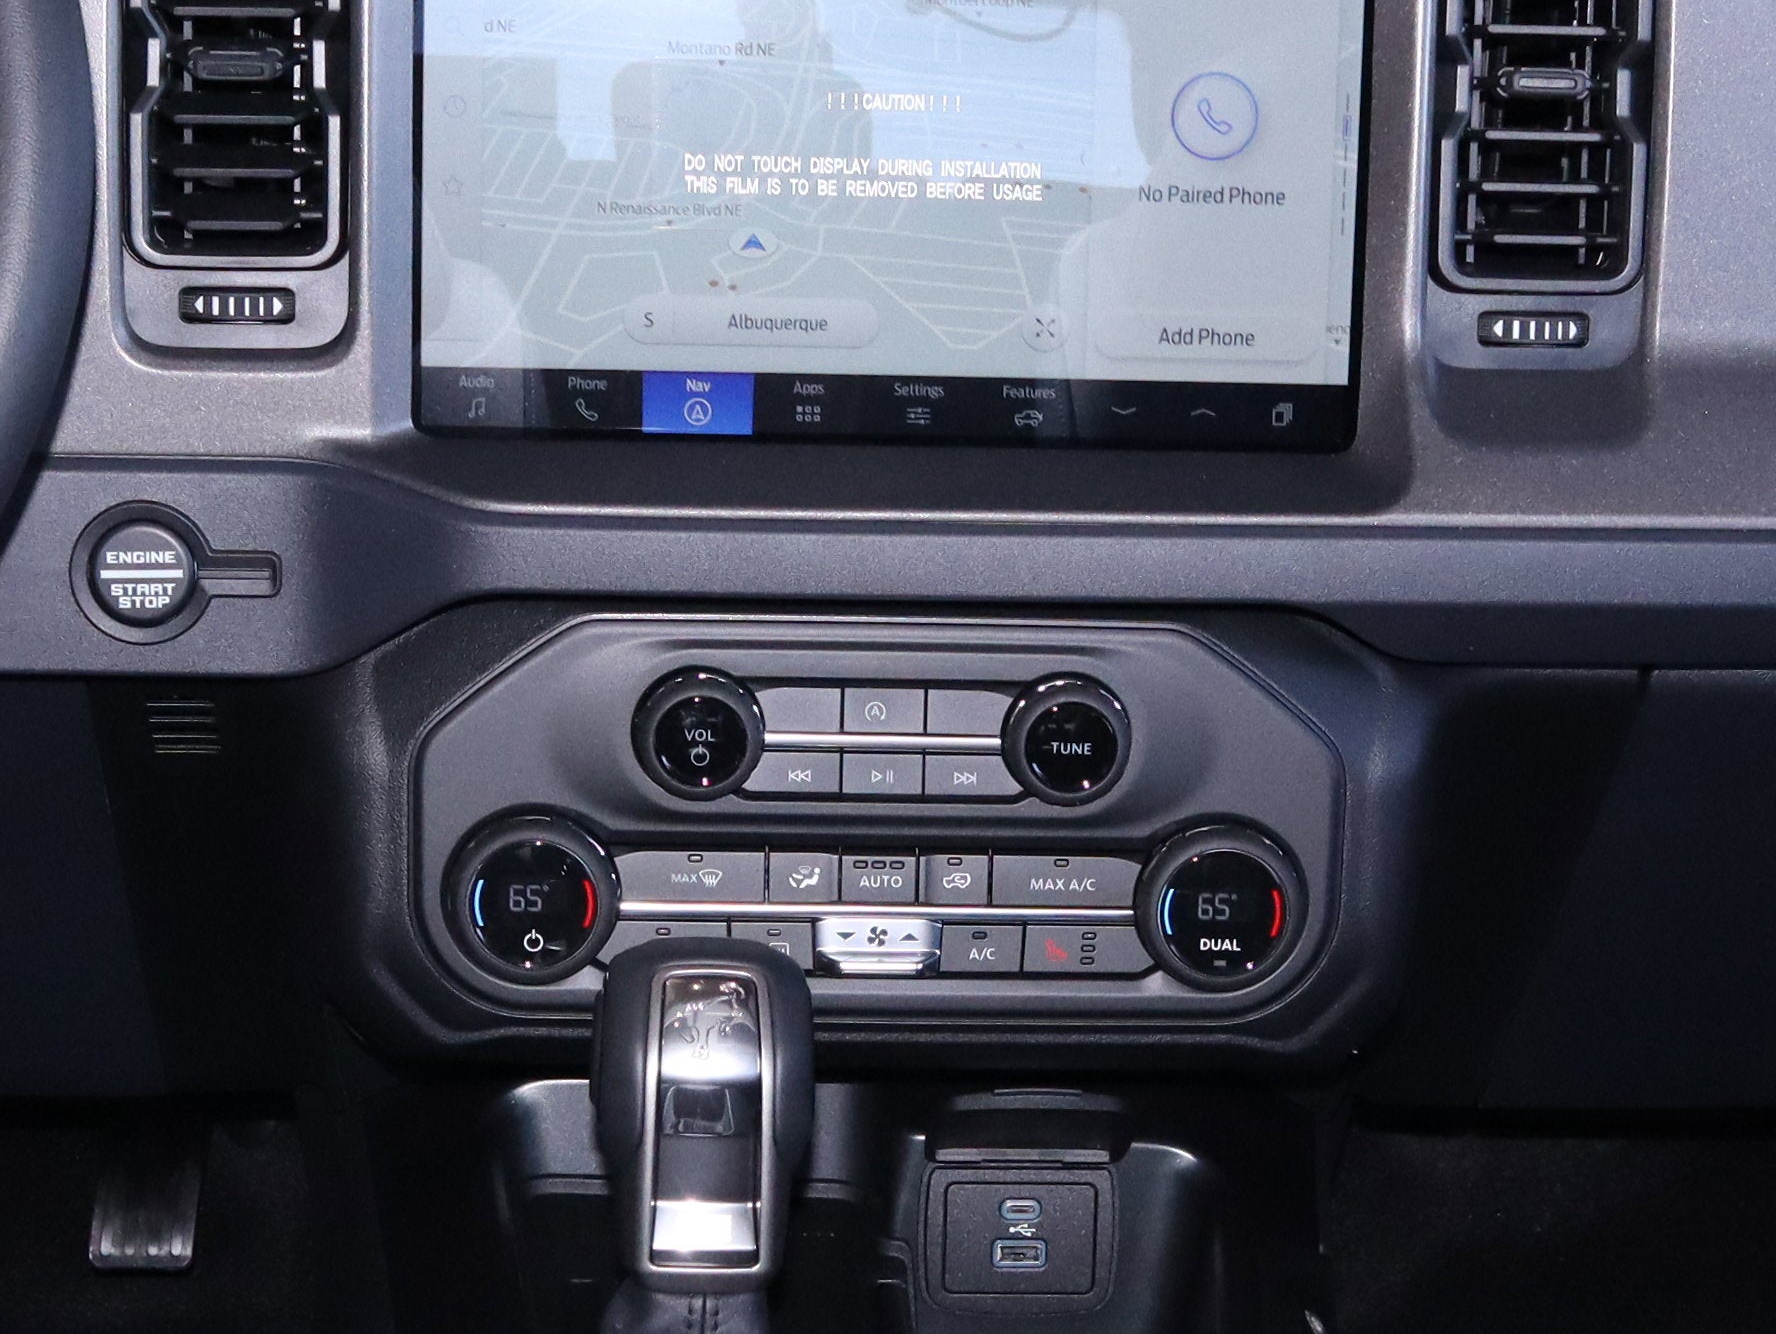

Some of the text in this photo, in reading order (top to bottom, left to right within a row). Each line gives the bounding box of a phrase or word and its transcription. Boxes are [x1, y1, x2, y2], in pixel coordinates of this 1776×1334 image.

[498, 19, 517, 33] NE
[735, 42, 752, 56] Rd
[756, 43, 776, 56] NE
[684, 154, 1042, 179] DO NOT TOUCH DISPLAY DURING INSTALLATION
[685, 175, 1043, 201] THIS FILM IS TO BE REMOVED BEFORE USAGE
[1138, 186, 1286, 206] No Paired Phone
[597, 201, 743, 216] N Renaissance Blvd NE
[644, 313, 654, 328] S
[728, 314, 828, 334] Albuquerque
[1159, 328, 1255, 347] Add Phone
[459, 374, 494, 389] Audio
[568, 376, 607, 392] Phone
[686, 379, 711, 392] Nav
[793, 381, 824, 397] Apps
[894, 383, 945, 399] Settings
[1002, 385, 1056, 399] Features
[106, 551, 176, 564] ENGINE
[111, 583, 175, 596] START
[119, 596, 170, 609] STOP
[685, 729, 715, 741] VOL
[1050, 742, 1092, 755] TUNE
[671, 872, 697, 884] MAX
[859, 875, 903, 888] AUTO
[1030, 877, 1096, 892] MAX A/C
[1199, 938, 1240, 952] DUAL
[969, 946, 995, 962] A/C
